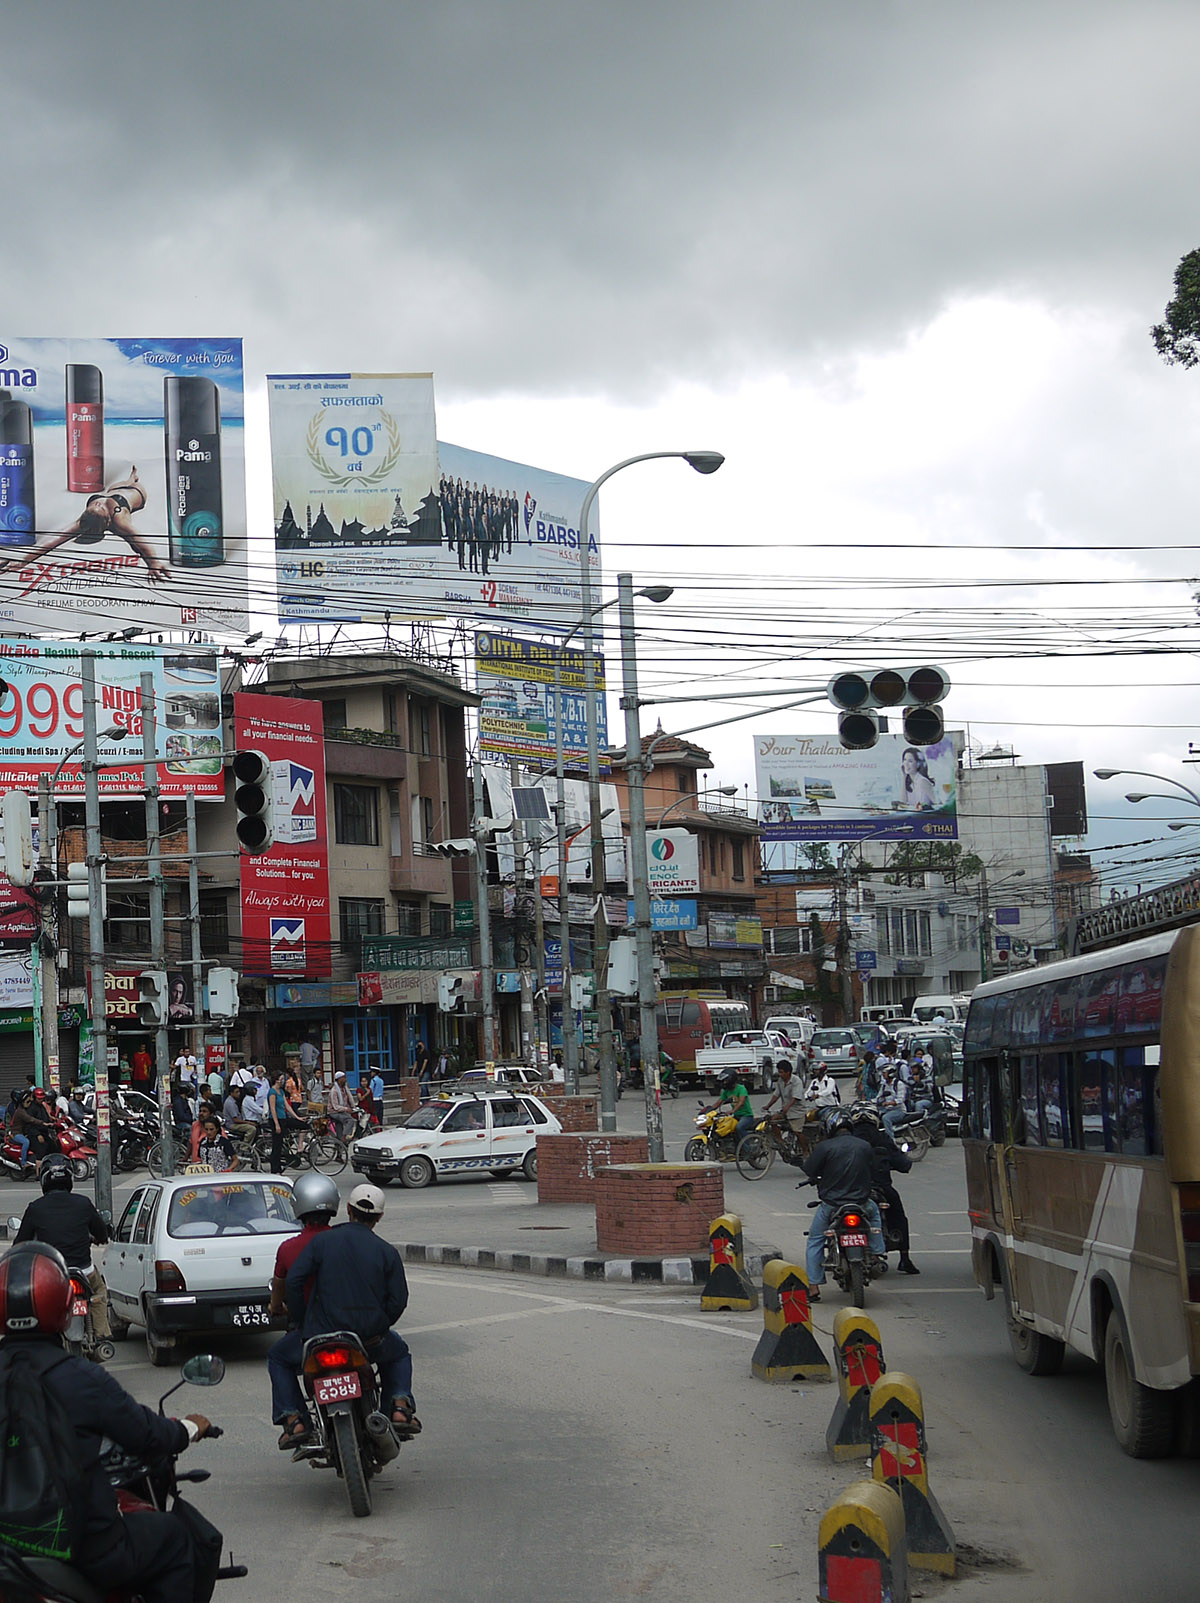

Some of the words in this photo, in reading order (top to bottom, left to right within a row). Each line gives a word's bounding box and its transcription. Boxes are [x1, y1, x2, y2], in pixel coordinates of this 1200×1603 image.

[143, 351, 182, 365] Forever
[186, 351, 211, 364] with
[214, 353, 235, 368] you
[320, 393, 383, 407] सफलताको
[72, 413, 97, 422] Pama
[0, 457, 26, 466] Pama
[176, 449, 211, 461] Pama
[347, 461, 363, 473] वर्ष
[178, 475, 186, 517] Roadies
[301, 561, 324, 578] LIC
[480, 581, 497, 608] +2
[37, 599, 74, 608] PERFUME
[77, 600, 130, 608] DEODORANT
[44, 647, 79, 660] Health
[121, 648, 155, 661] Resort
[262, 718, 277, 728] have
[278, 720, 303, 731] answers
[304, 723, 311, 731] to
[481, 717, 525, 731] POLYTECHNIC
[243, 728, 251, 737] all
[252, 731, 266, 740] your
[268, 730, 294, 742] financial
[26, 747, 44, 755] Medi
[45, 748, 59, 756] Spa
[760, 738, 796, 756] Your
[795, 737, 851, 756] Thailand
[121, 772, 140, 782] Pvt.
[932, 825, 953, 833] THAI
[249, 857, 261, 865] and
[263, 857, 292, 868] Complete
[294, 858, 320, 868] Financial
[292, 870, 301, 878] for
[302, 871, 315, 881] you.
[245, 890, 280, 910] Always
[282, 894, 304, 908] with
[307, 898, 325, 911] you
[189, 1166, 211, 1174] TAXI
[223, 1185, 244, 1195] TAXI
[271, 1186, 292, 1199] TAXI
[179, 1190, 198, 1207] TAXI
